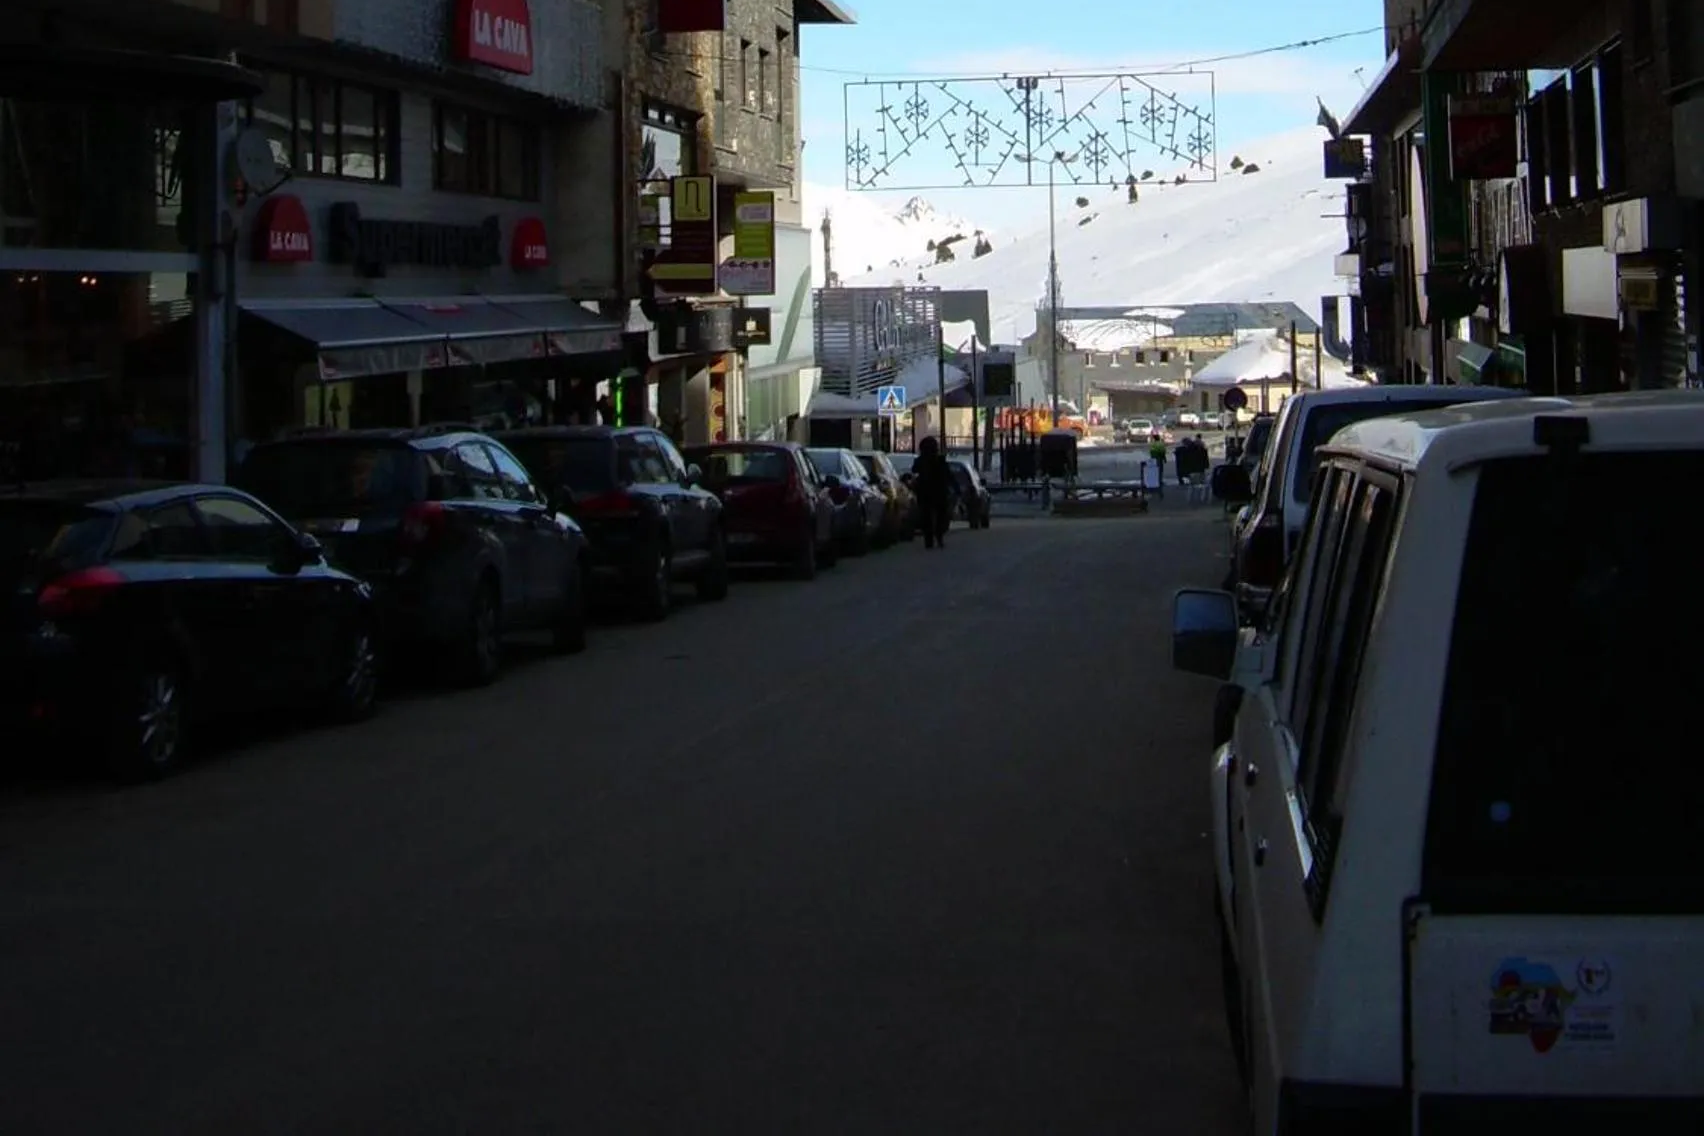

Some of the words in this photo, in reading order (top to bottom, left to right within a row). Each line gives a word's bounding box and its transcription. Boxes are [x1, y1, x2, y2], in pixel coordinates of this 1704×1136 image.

[474, 8, 491, 47] LA
[493, 15, 528, 57] CAVA
[269, 230, 283, 251] LA
[284, 231, 310, 253] CAVA
